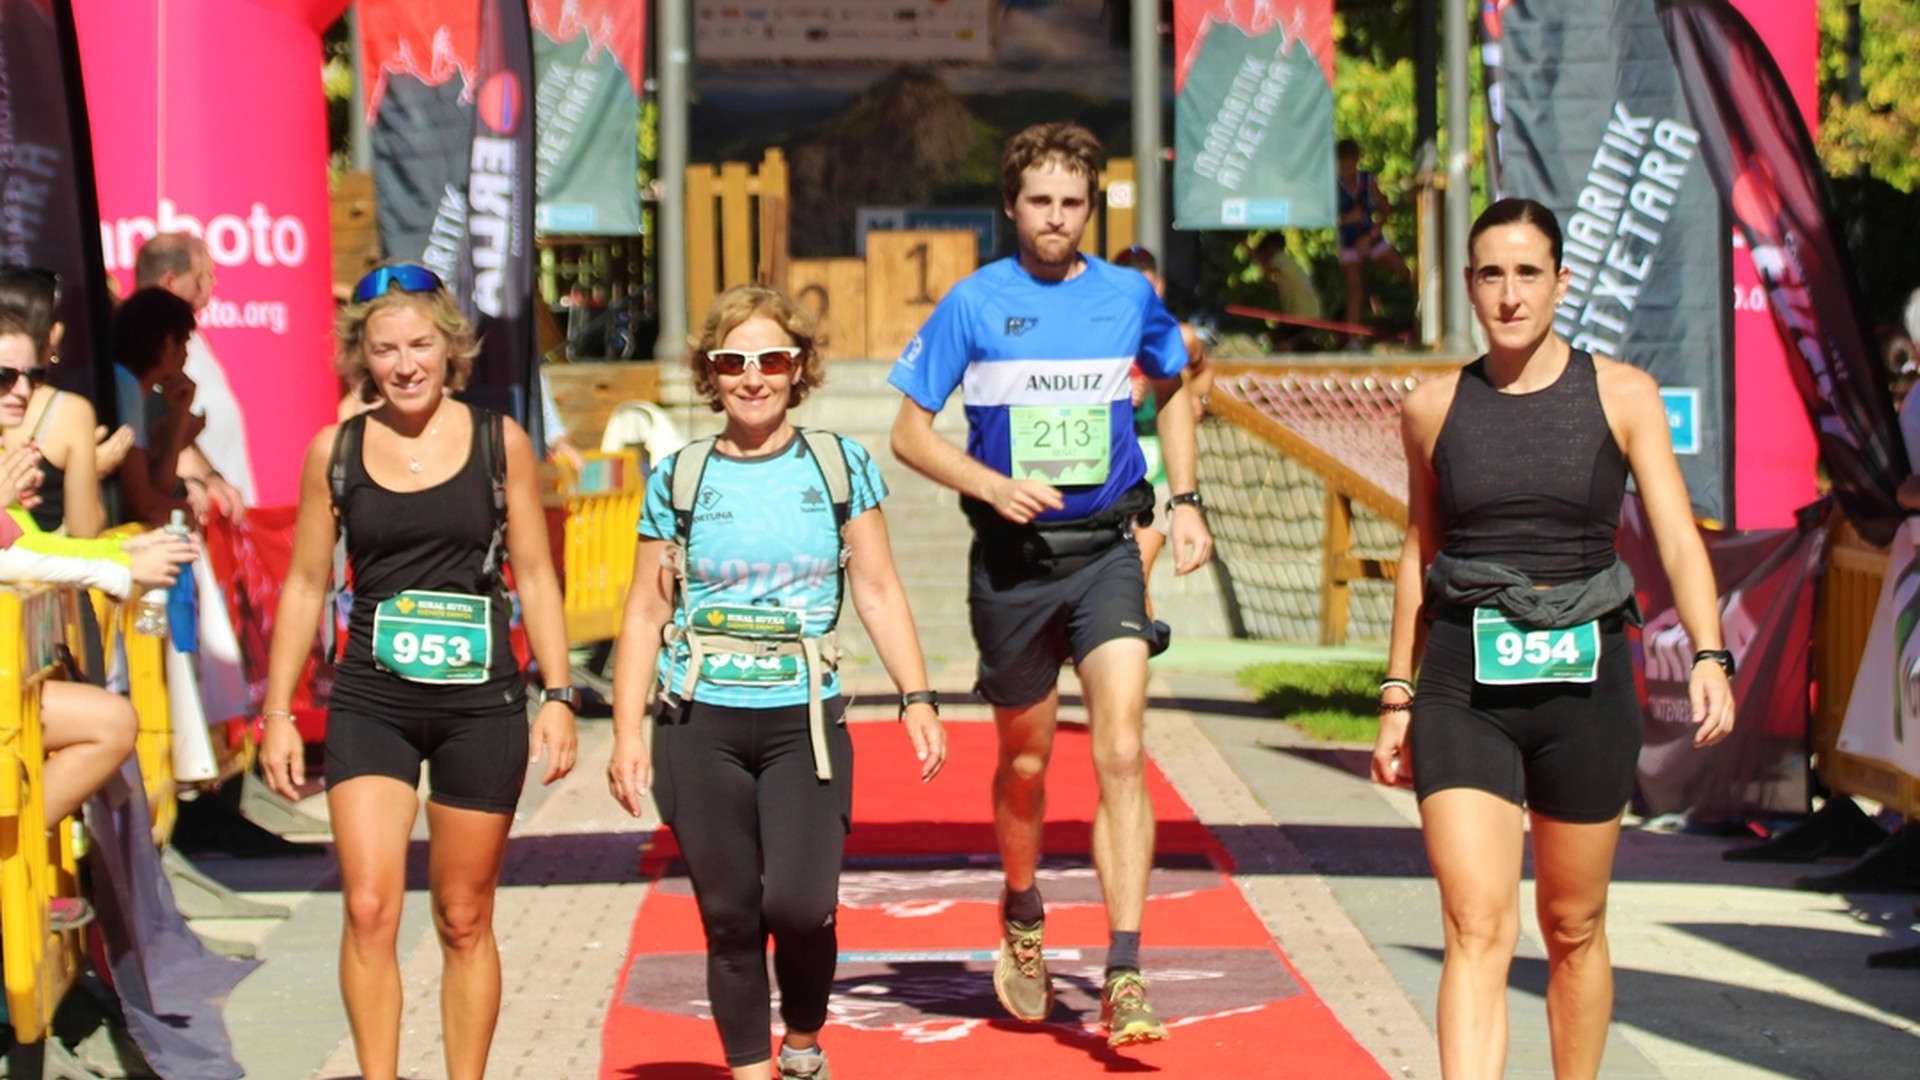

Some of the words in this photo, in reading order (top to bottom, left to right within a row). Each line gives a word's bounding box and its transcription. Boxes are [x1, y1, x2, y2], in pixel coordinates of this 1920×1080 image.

[1216, 59, 1294, 191] ATXETARA
[101, 198, 307, 270] nboto
[422, 183, 467, 283] RITIK
[1571, 118, 1701, 355] ATXETARA
[905, 242, 937, 305] 1
[1026, 374, 1103, 391] ANDUTZ
[1033, 420, 1091, 447] 213
[392, 631, 473, 667] 953
[1495, 631, 1580, 666] 954
